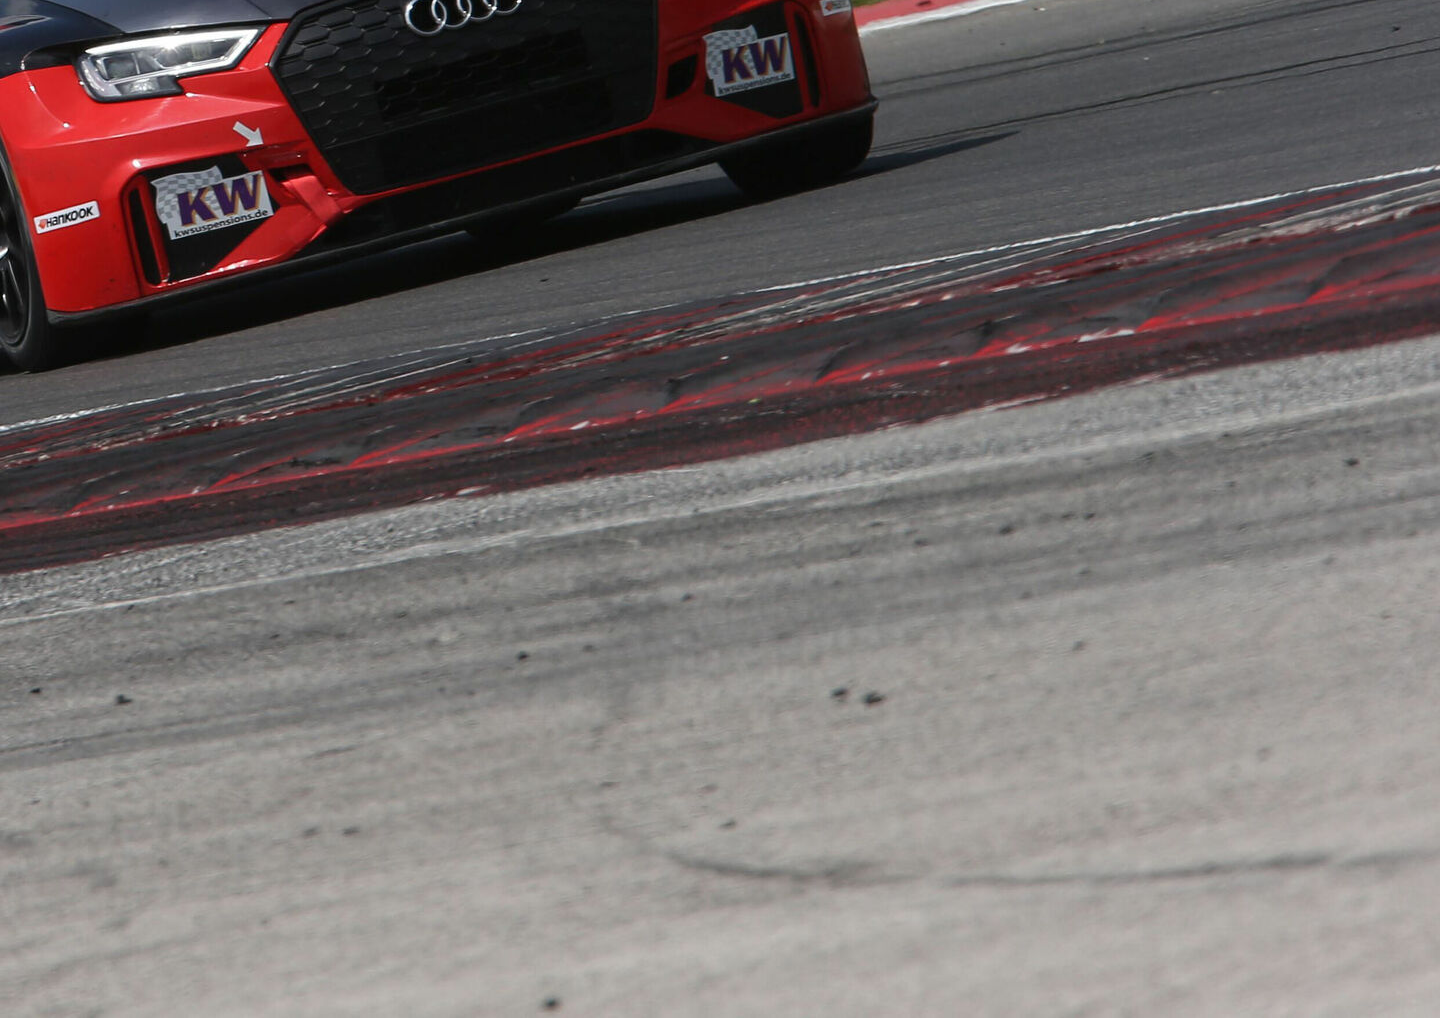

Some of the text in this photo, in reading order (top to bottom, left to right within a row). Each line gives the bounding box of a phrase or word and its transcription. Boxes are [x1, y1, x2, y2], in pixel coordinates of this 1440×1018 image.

[721, 36, 787, 84] KW
[718, 72, 791, 95] kwsuspensions.de
[177, 174, 262, 227] KW
[174, 208, 268, 238] kwsuspensions.de
